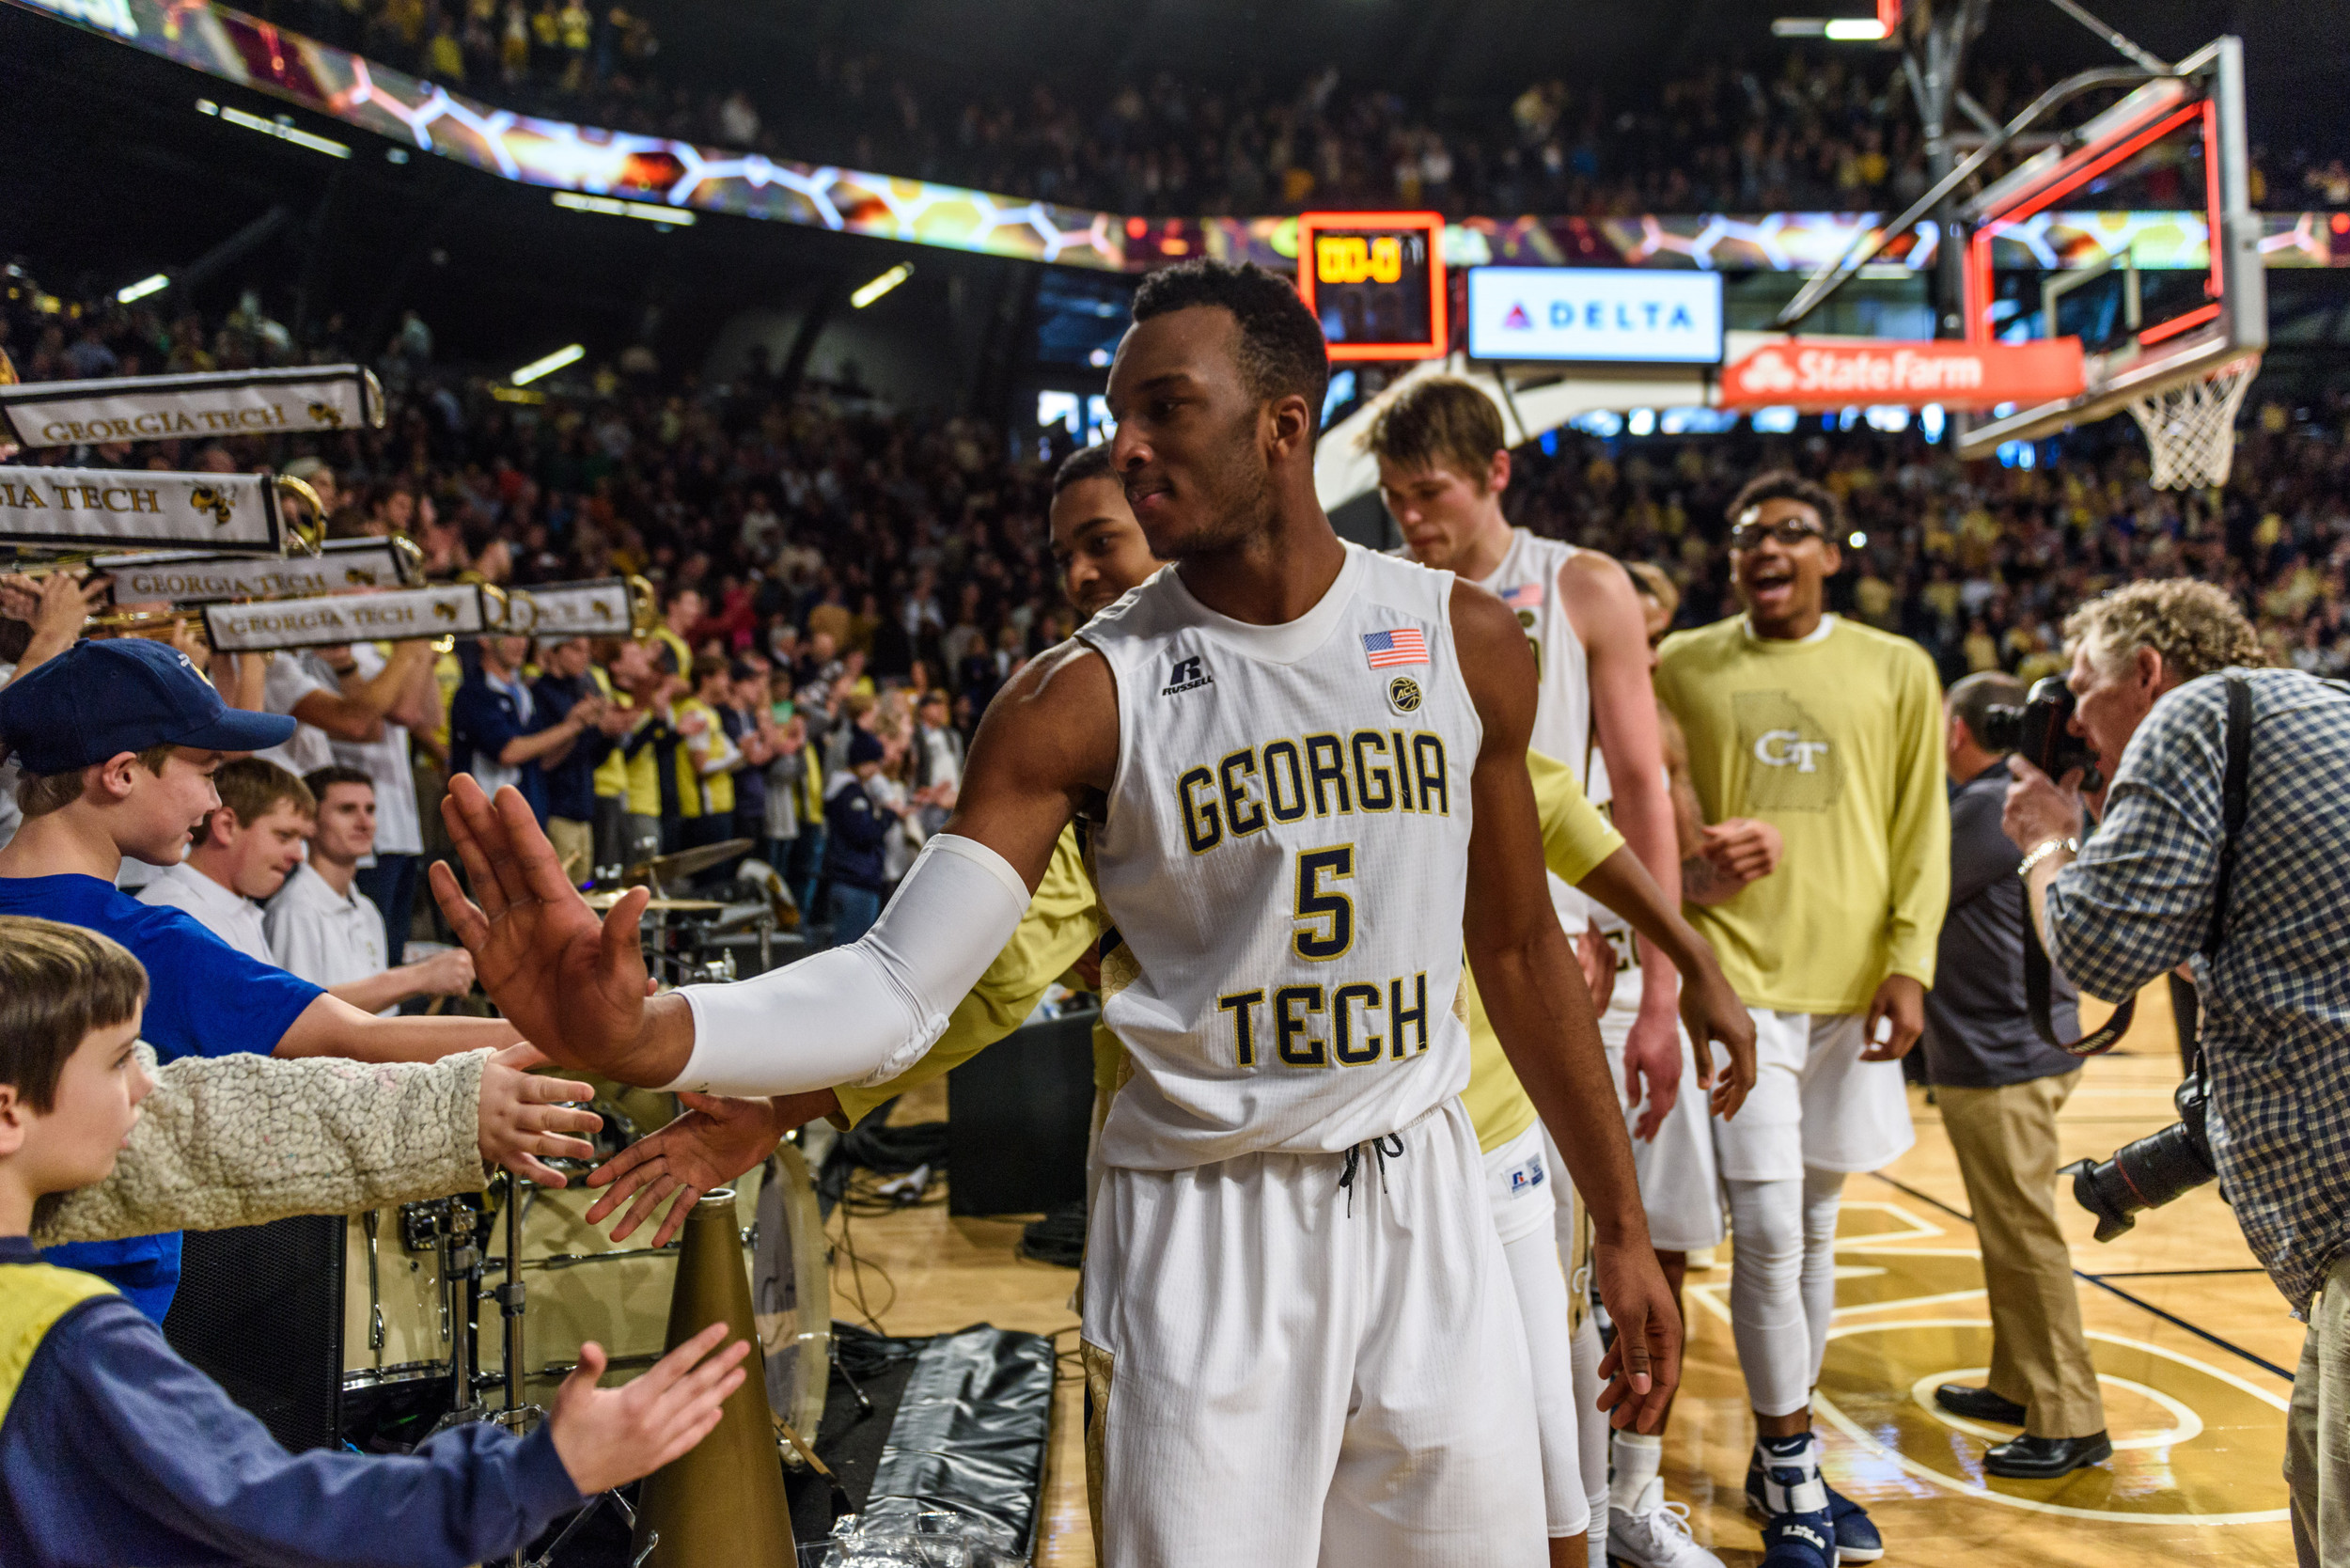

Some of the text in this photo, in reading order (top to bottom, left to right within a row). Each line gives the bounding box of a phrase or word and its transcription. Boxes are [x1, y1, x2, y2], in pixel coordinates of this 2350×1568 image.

[1548, 301, 1694, 330] DELTA
[42, 404, 287, 443] GEORGIA TECH
[52, 484, 160, 513] TECH
[132, 572, 326, 596] GEORGIA TECH
[228, 607, 415, 635] GEORGIA TECH
[1162, 675, 1214, 697] RUSSELL
[1396, 683, 1418, 700] ACC
[1754, 729, 1827, 773] GT
[1176, 728, 1450, 856] GEORGIA
[1292, 842, 1355, 963] 5
[1218, 970, 1430, 1069] TECH
